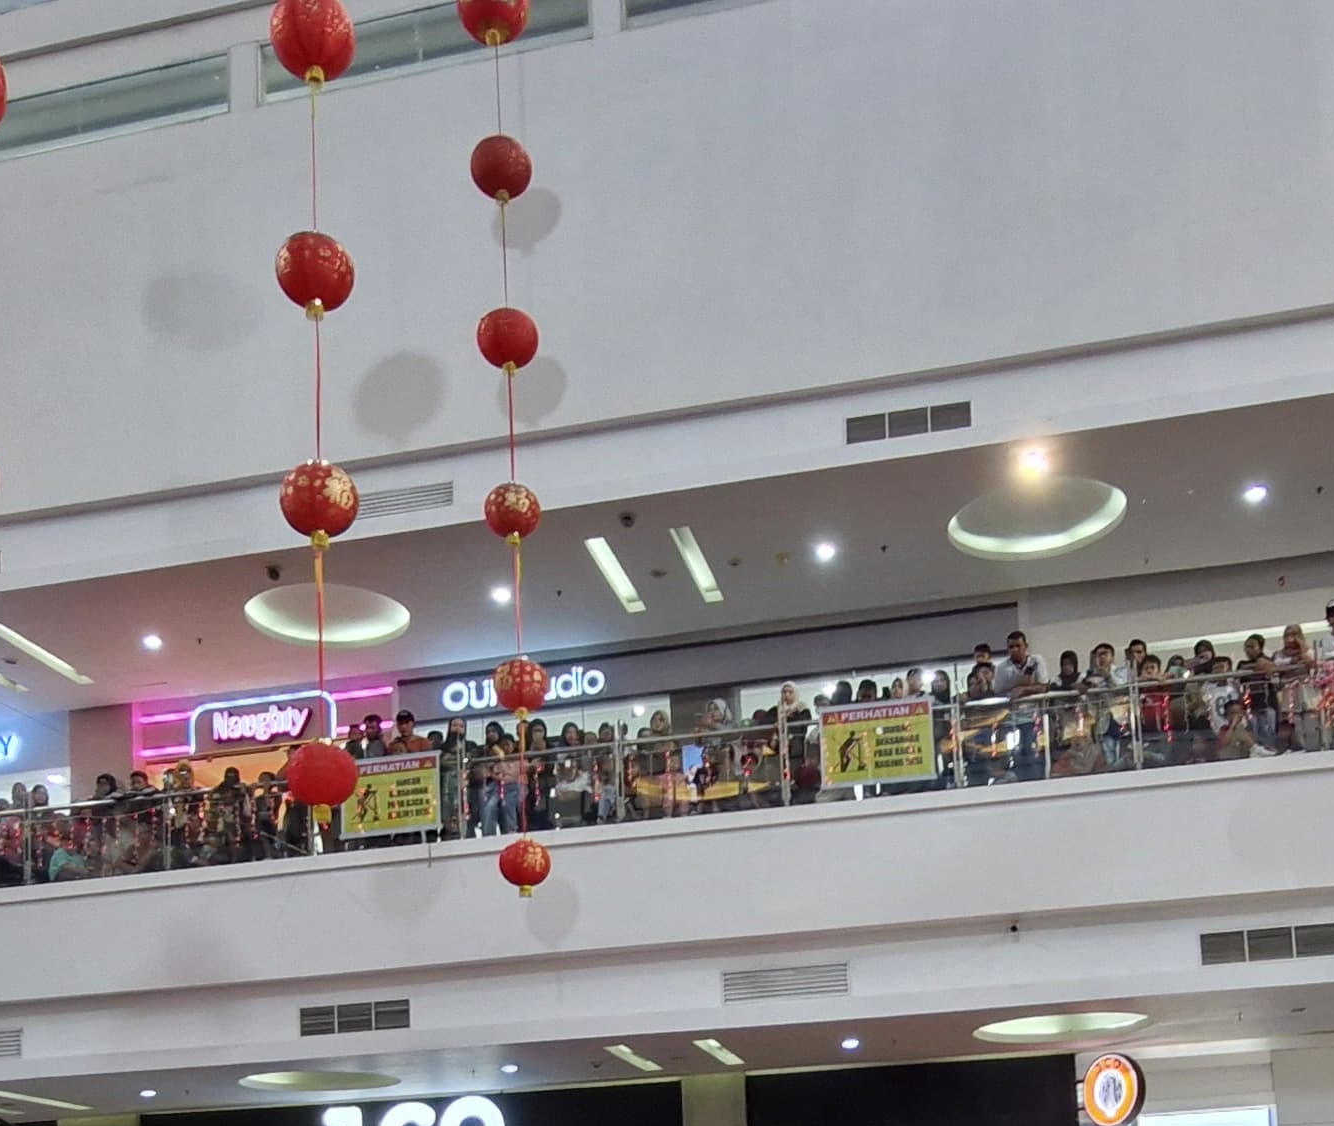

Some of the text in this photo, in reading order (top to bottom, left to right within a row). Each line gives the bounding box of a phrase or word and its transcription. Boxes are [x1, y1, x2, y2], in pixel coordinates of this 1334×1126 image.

[840, 705, 910, 722] PERHATIAN
[213, 704, 309, 741] Naughty
[359, 760, 420, 775] PERHATIAN
